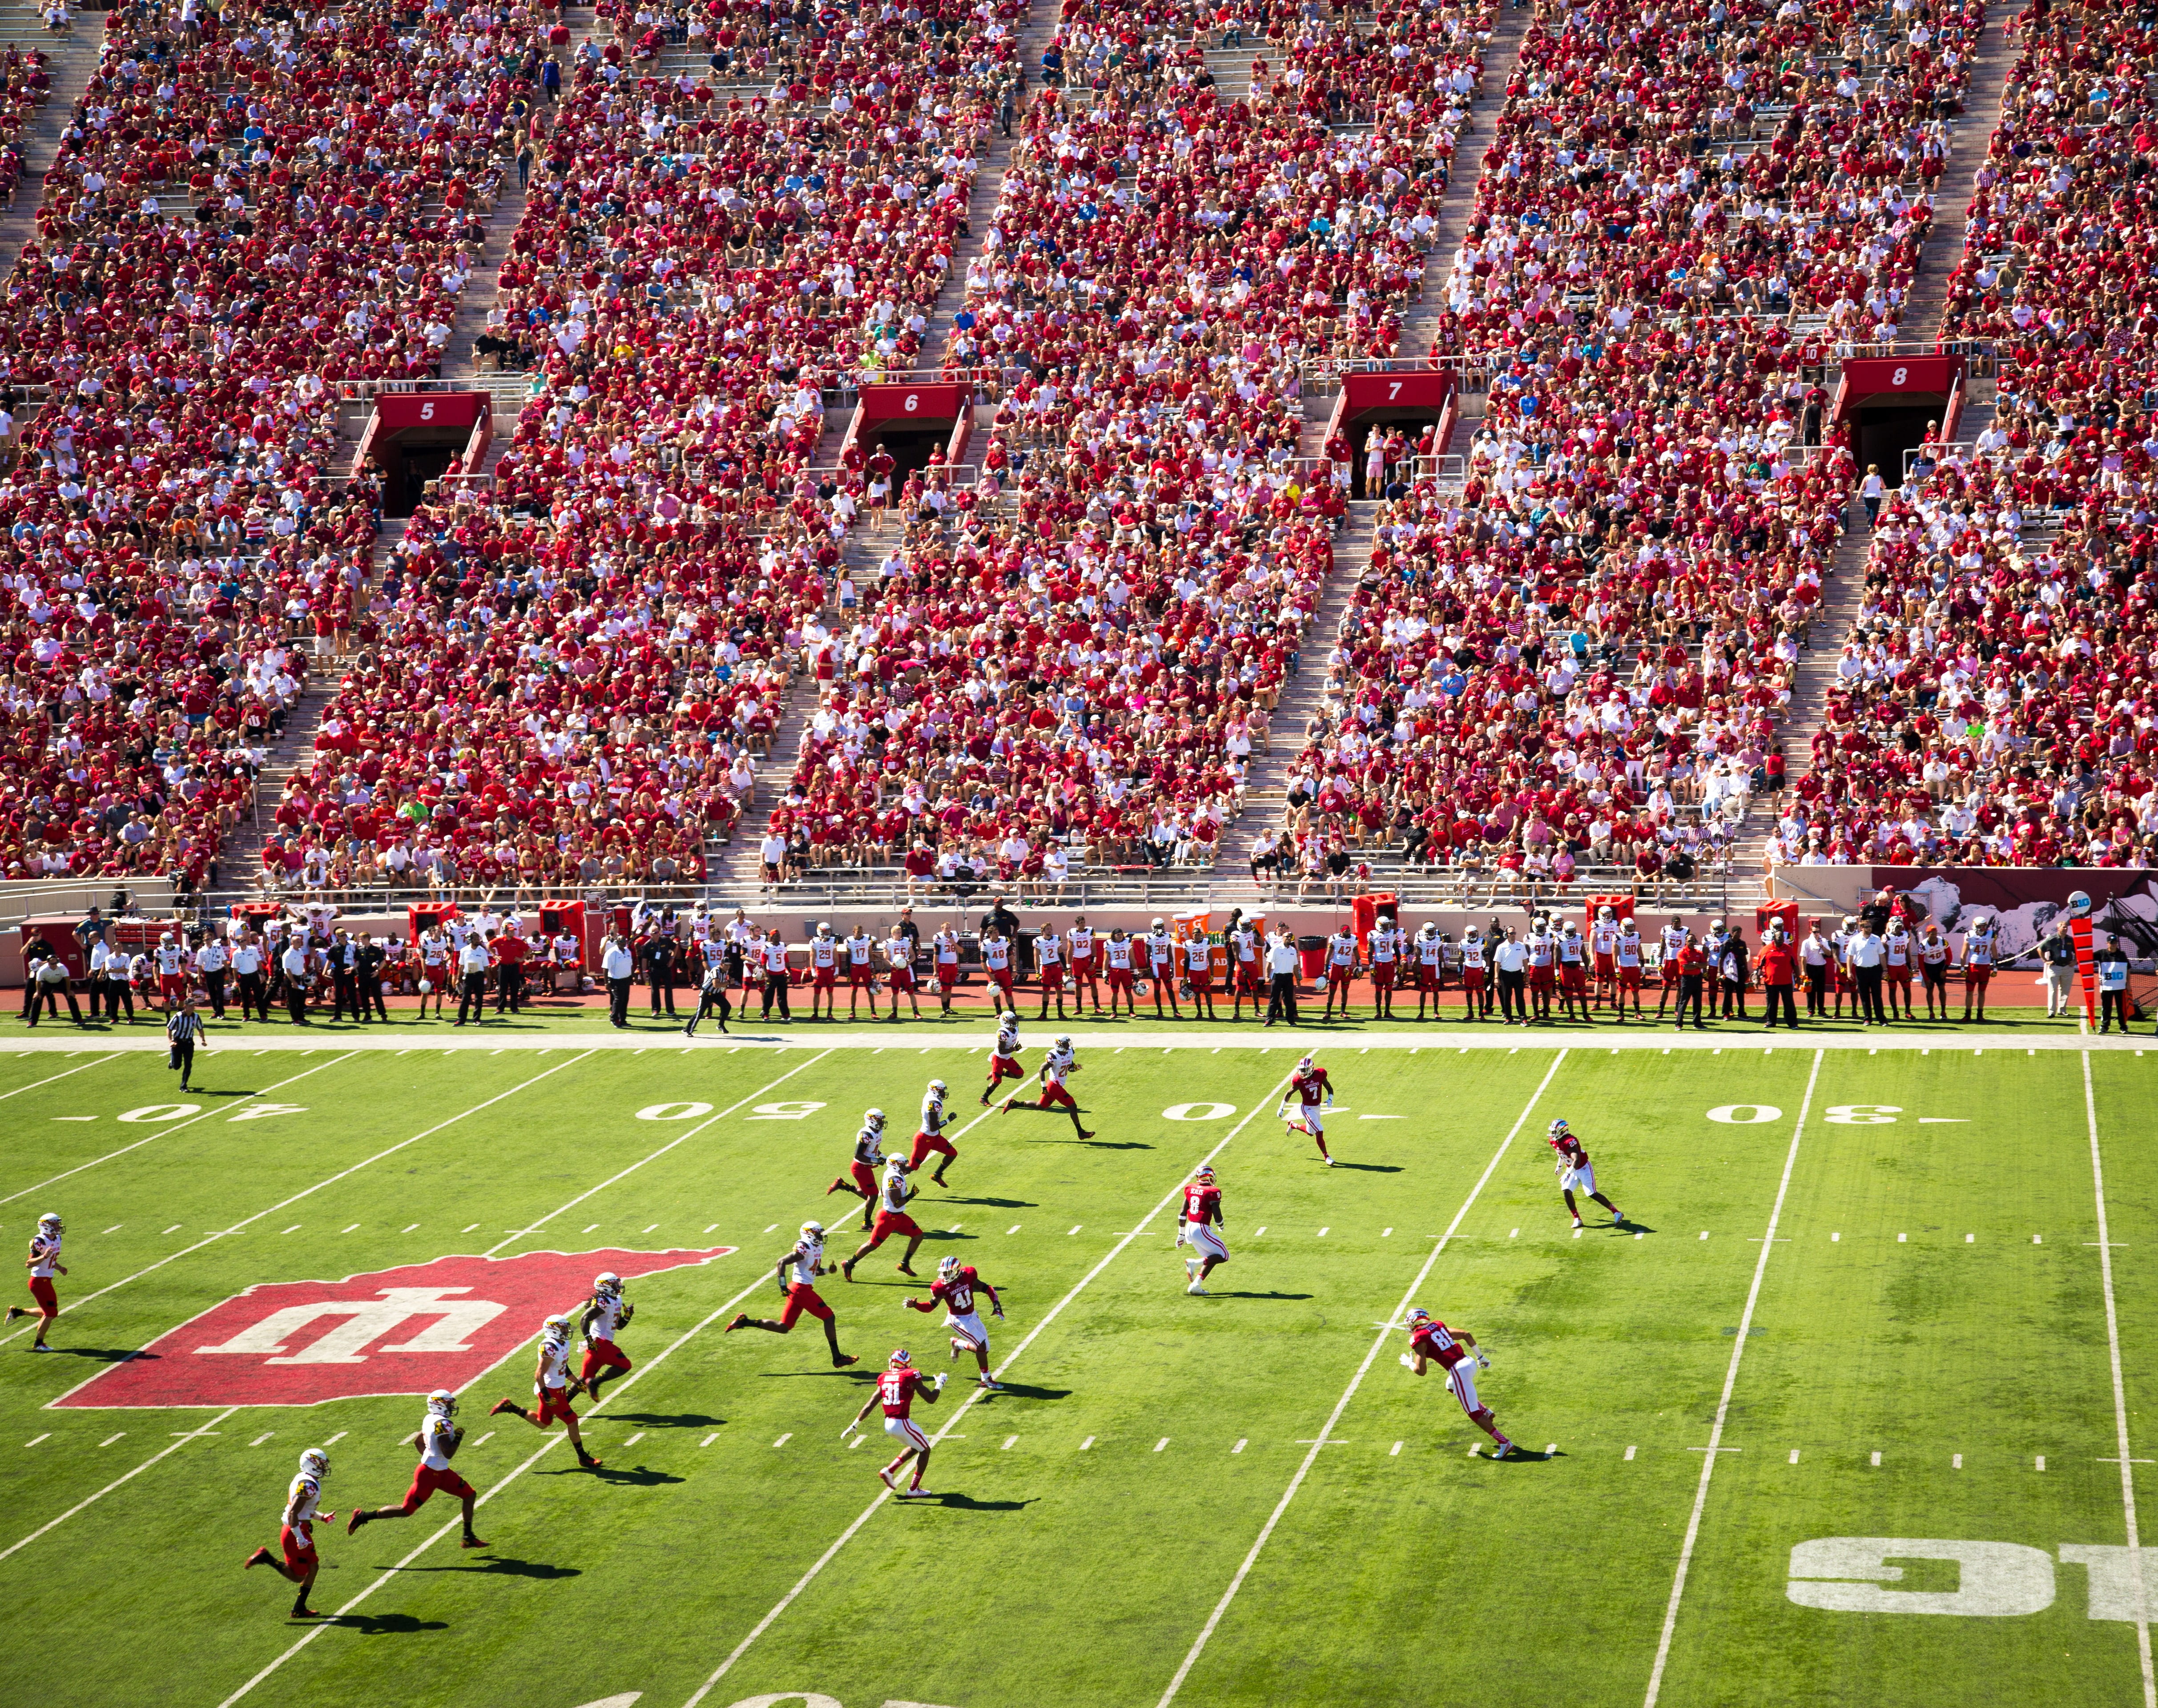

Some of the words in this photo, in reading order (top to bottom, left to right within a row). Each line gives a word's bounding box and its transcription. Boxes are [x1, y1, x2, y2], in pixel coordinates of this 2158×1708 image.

[1806, 348, 1817, 359] 10
[1892, 368, 1907, 385] 8
[1389, 383, 1402, 399] 7
[905, 395, 918, 411] 6
[420, 403, 434, 419] 5
[248, 715, 261, 727] IU
[1178, 923, 1186, 932] G
[1380, 941, 1389, 952] 51
[1669, 940, 1682, 948] 52
[709, 950, 722, 960] 59
[819, 950, 830, 959] 29
[855, 948, 865, 957] 17
[1048, 949, 1054, 958] 2
[1114, 950, 1126, 959] 33
[1338, 946, 1351, 956] 42
[1426, 949, 1435, 957] 14
[1535, 945, 1547, 955] 97
[1973, 945, 1988, 955] 47
[776, 953, 781, 964] 5
[169, 959, 175, 969] 3
[1309, 1087, 1317, 1100] 7
[1569, 1139, 1577, 1147] 26
[1190, 1196, 1200, 1215] 8
[950, 1284, 970, 1296] HOOSIERS
[954, 1289, 971, 1309] 41
[915, 1371, 921, 1379] 31
[882, 1383, 900, 1405] 31
